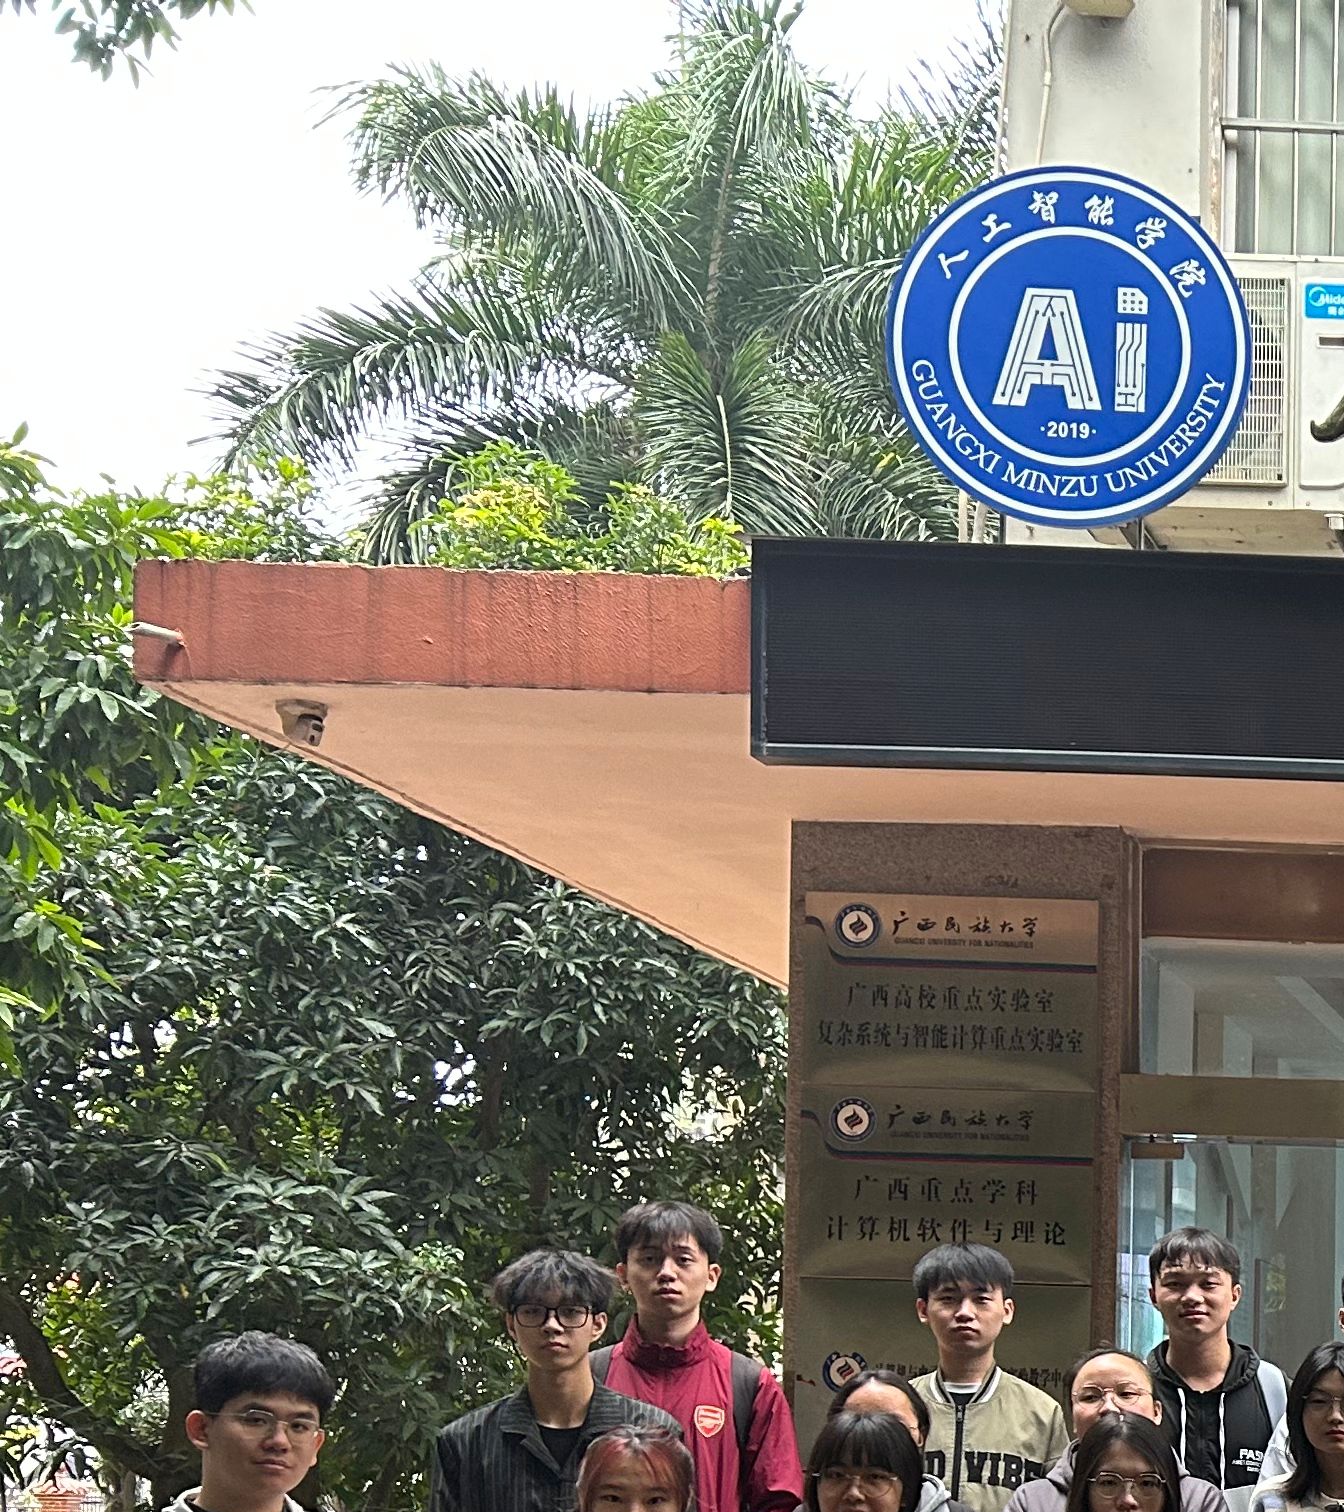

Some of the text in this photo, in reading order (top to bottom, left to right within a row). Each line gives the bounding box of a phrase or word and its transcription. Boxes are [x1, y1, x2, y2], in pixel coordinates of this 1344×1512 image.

[938, 190, 1207, 298] 人工智能学院
[912, 358, 1227, 497] GUANGXI MINZU UNIVERSITY
[891, 910, 1040, 938] 广西民族大学
[849, 981, 1055, 1014] 广西高校重点实验室
[818, 1019, 1085, 1054] 复杂系统与智能计算重点实验室
[853, 1175, 1039, 1207] 广西重点学科
[826, 1215, 1067, 1246] 计算机软件与理论
